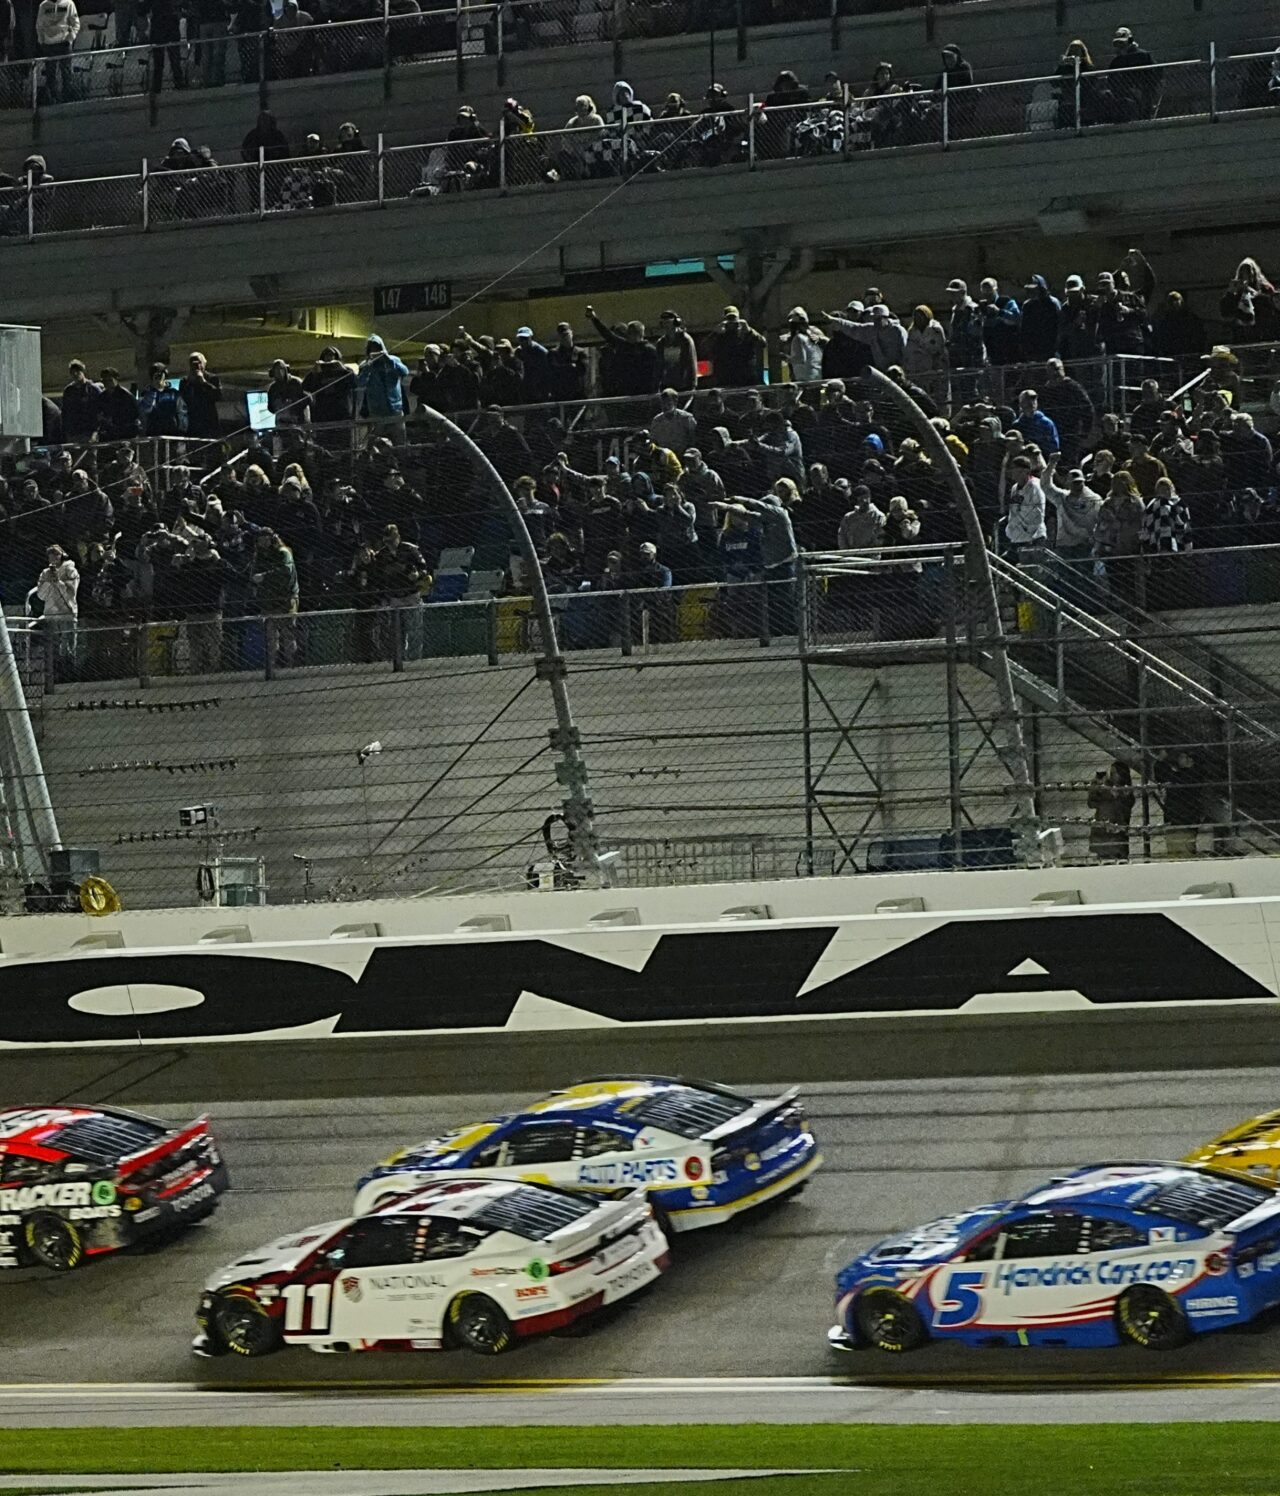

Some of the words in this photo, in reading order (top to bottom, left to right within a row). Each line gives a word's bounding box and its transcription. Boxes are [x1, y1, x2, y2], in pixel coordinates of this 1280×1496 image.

[381, 287, 401, 310] 147
[423, 283, 447, 306] 146
[578, 1163, 616, 1184] AUTO
[622, 1158, 677, 1182] PARTS
[69, 1205, 122, 1220] BOATS
[369, 1275, 448, 1290] NATIONAL
[281, 1283, 332, 1331] 11
[932, 1269, 987, 1328] 5
[1185, 1295, 1239, 1310] HIRING
